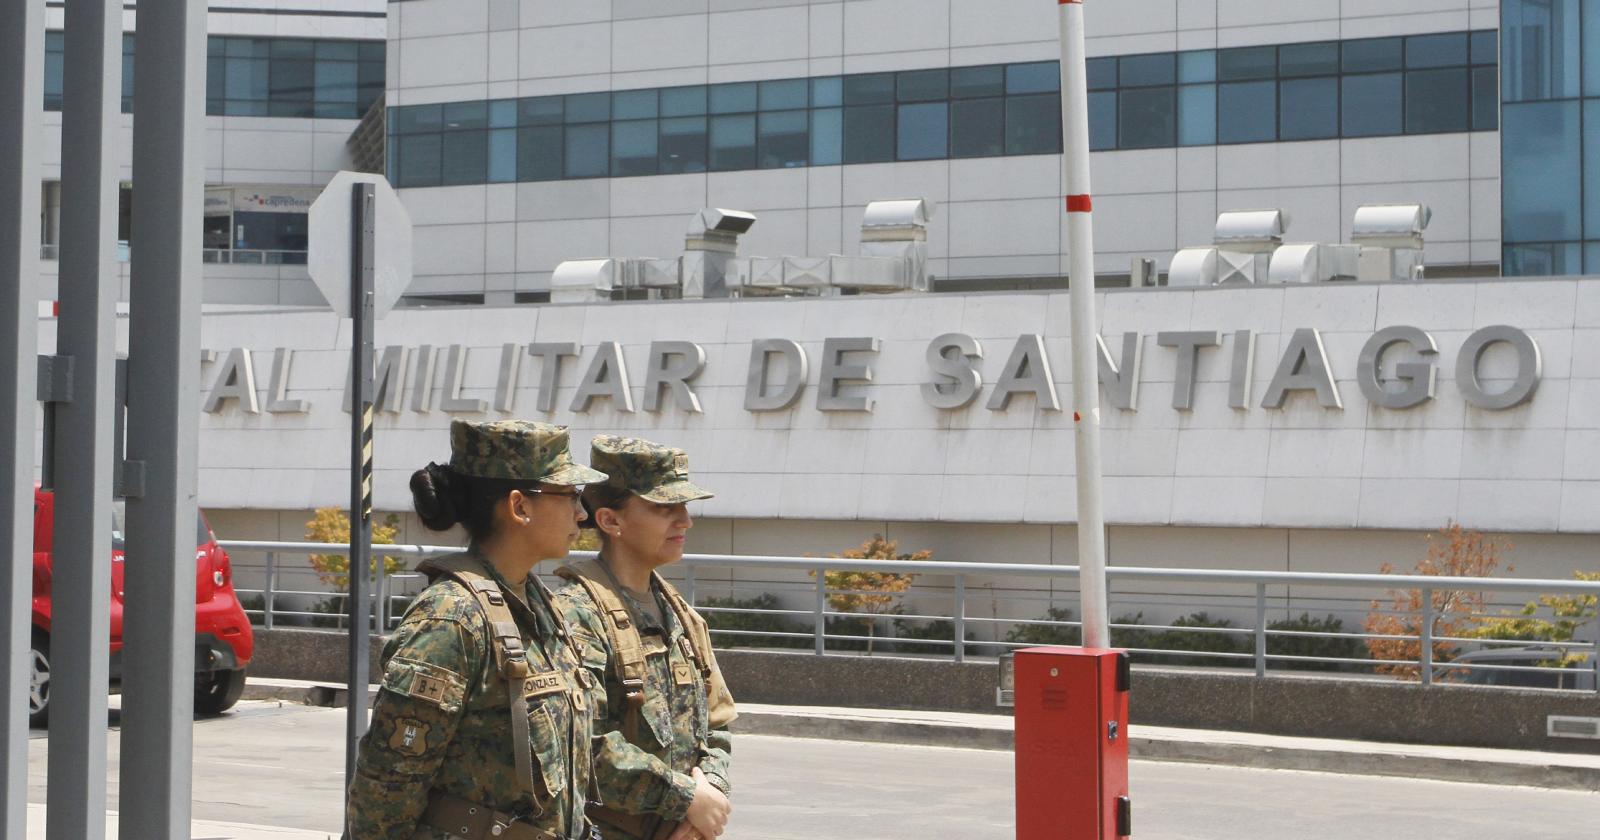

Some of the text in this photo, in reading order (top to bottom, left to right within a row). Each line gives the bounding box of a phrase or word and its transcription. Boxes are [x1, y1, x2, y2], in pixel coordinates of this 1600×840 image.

[342, 338, 706, 414] MILITAR
[743, 336, 882, 413] DE
[919, 324, 1544, 413] SANTIAGO
[524, 677, 560, 691] ONZALEZ
